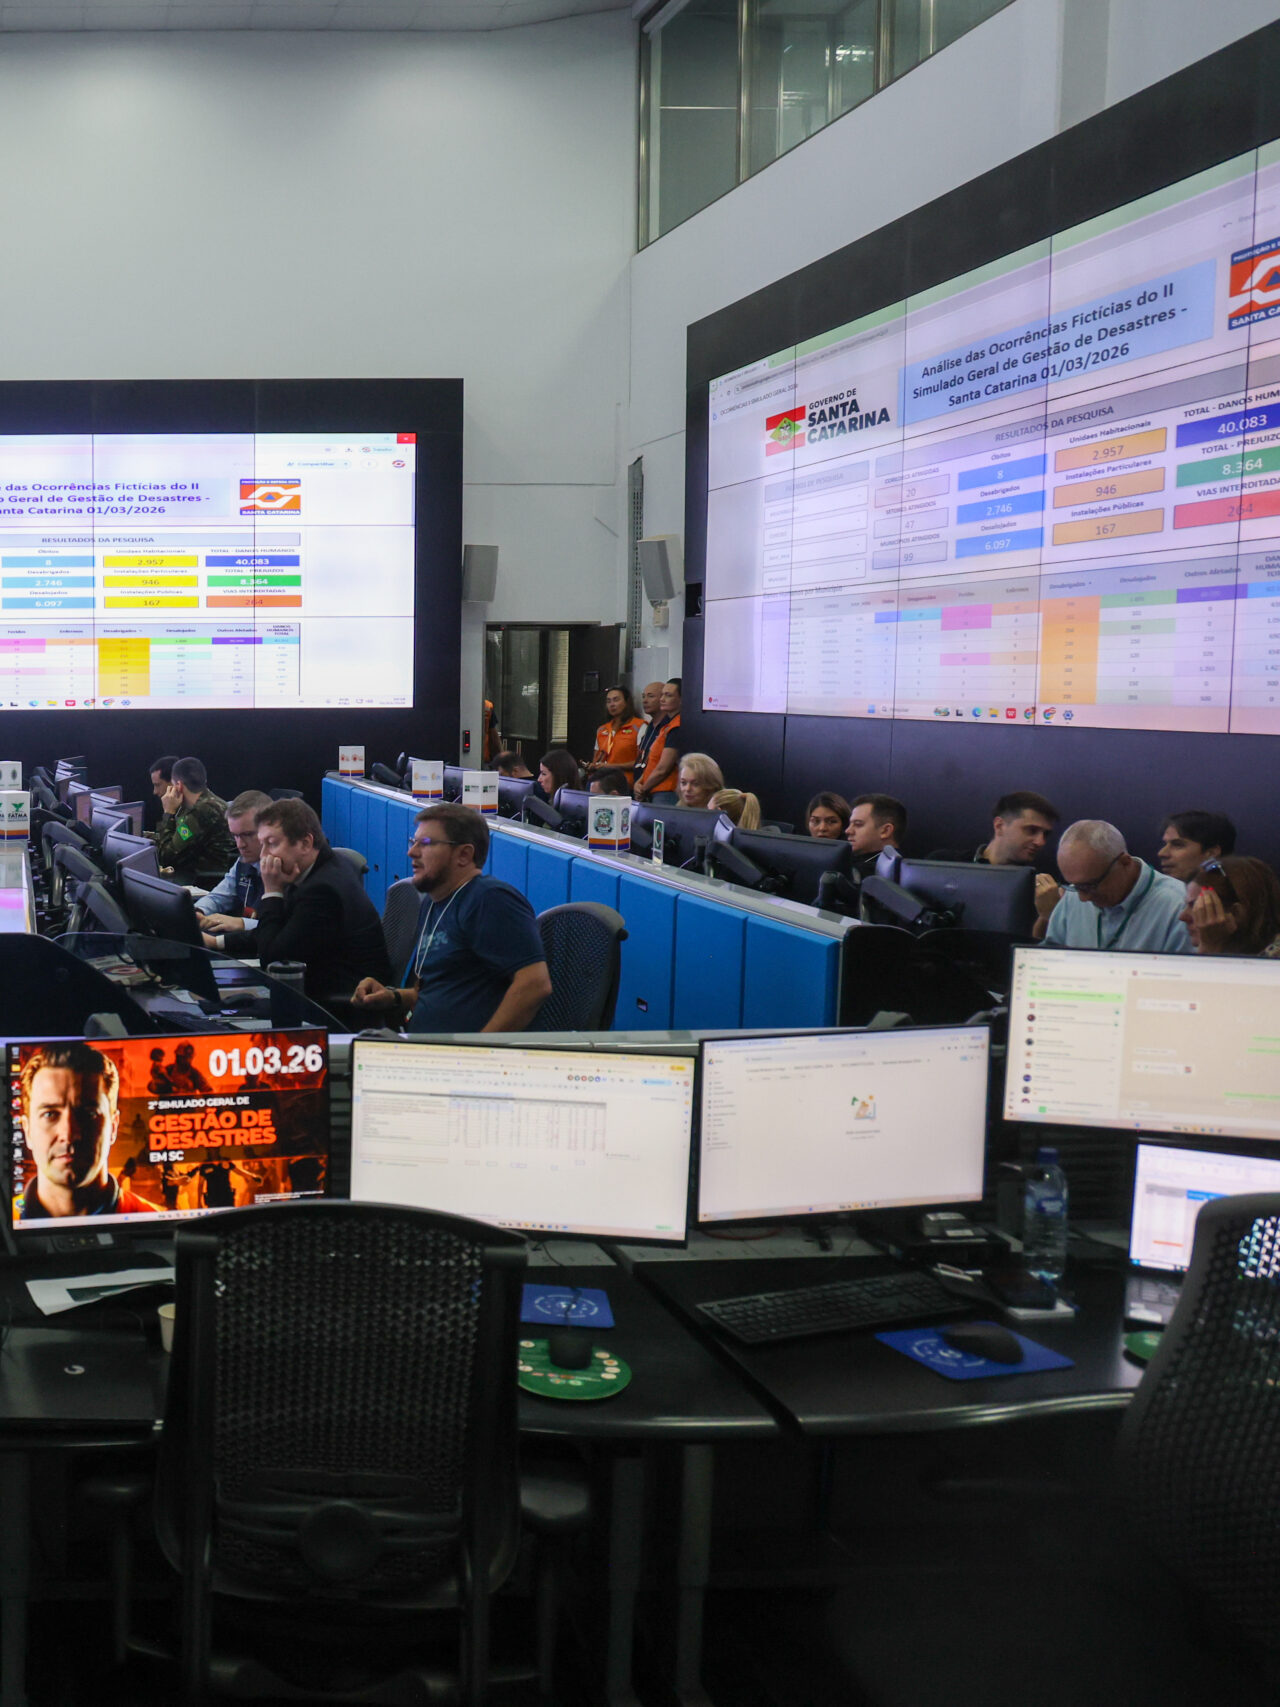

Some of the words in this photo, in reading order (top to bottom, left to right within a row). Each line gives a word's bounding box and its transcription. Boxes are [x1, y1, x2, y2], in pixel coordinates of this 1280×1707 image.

[1231, 312, 1266, 327] SANTA
[921, 356, 962, 379] Análise
[964, 347, 986, 365] das
[988, 320, 1068, 356] Ocorrências
[1071, 300, 1132, 329] Fictícias
[1136, 290, 1158, 309] do
[1163, 282, 1174, 298] II
[912, 374, 965, 400] Simulado
[967, 361, 999, 383] Geral
[1002, 353, 1018, 370] de
[1021, 337, 1070, 365] Gestão
[1074, 331, 1094, 349] de
[1097, 307, 1176, 342] Desastres
[948, 387, 981, 407] Santa
[984, 371, 1037, 397] Catarina
[1040, 343, 1130, 380] 01/03/2026
[808, 391, 845, 411] GOVERNO
[846, 388, 857, 398] DE
[807, 398, 860, 428] SANTA
[1184, 406, 1210, 418] TOTAL
[1218, 398, 1253, 411] DANOS
[806, 407, 891, 445] CATARINA
[995, 421, 1049, 442] RESULTADOS
[1051, 416, 1065, 428] DA
[1067, 406, 1115, 425] PESQUISA
[1217, 414, 1268, 435] 40.083
[1092, 445, 1124, 461] 2.957
[996, 469, 1004, 480] 8
[1065, 467, 1105, 482] Instalações
[1106, 459, 1152, 474] Particulares
[1222, 458, 1263, 475] 8.364
[5, 483, 28, 492] das
[31, 482, 111, 492] Ocorrências
[114, 482, 167, 491] Fictícias
[170, 482, 188, 491] do
[191, 482, 199, 490] II
[1096, 484, 1117, 497] 946
[8, 495, 44, 504] Geral
[47, 494, 63, 503] de
[67, 494, 114, 503] Gestão
[117, 494, 134, 502] de
[138, 493, 202, 502] Desastres
[28, 506, 83, 515] Catarina
[86, 505, 166, 516] 01/03/2026
[986, 503, 1013, 516] 2.746
[1071, 505, 1111, 518] Instalações
[1112, 500, 1144, 511] Públicas
[1227, 503, 1254, 517] 264
[1096, 523, 1116, 536] 167
[985, 538, 1011, 550] 6.097
[137, 558, 165, 566] 2.957
[235, 558, 270, 566] 40.083
[239, 577, 269, 586] 8.364
[209, 1044, 323, 1078] 01.03.26
[158, 1098, 206, 1109] SIMULADO
[206, 1096, 235, 1107] GERAL
[236, 1096, 250, 1105] DE
[148, 1108, 237, 1133] GESTÃO
[241, 1109, 272, 1127] DE
[149, 1126, 277, 1151] DESASTRES
[149, 1151, 167, 1163] EM
[168, 1150, 184, 1162] SC
